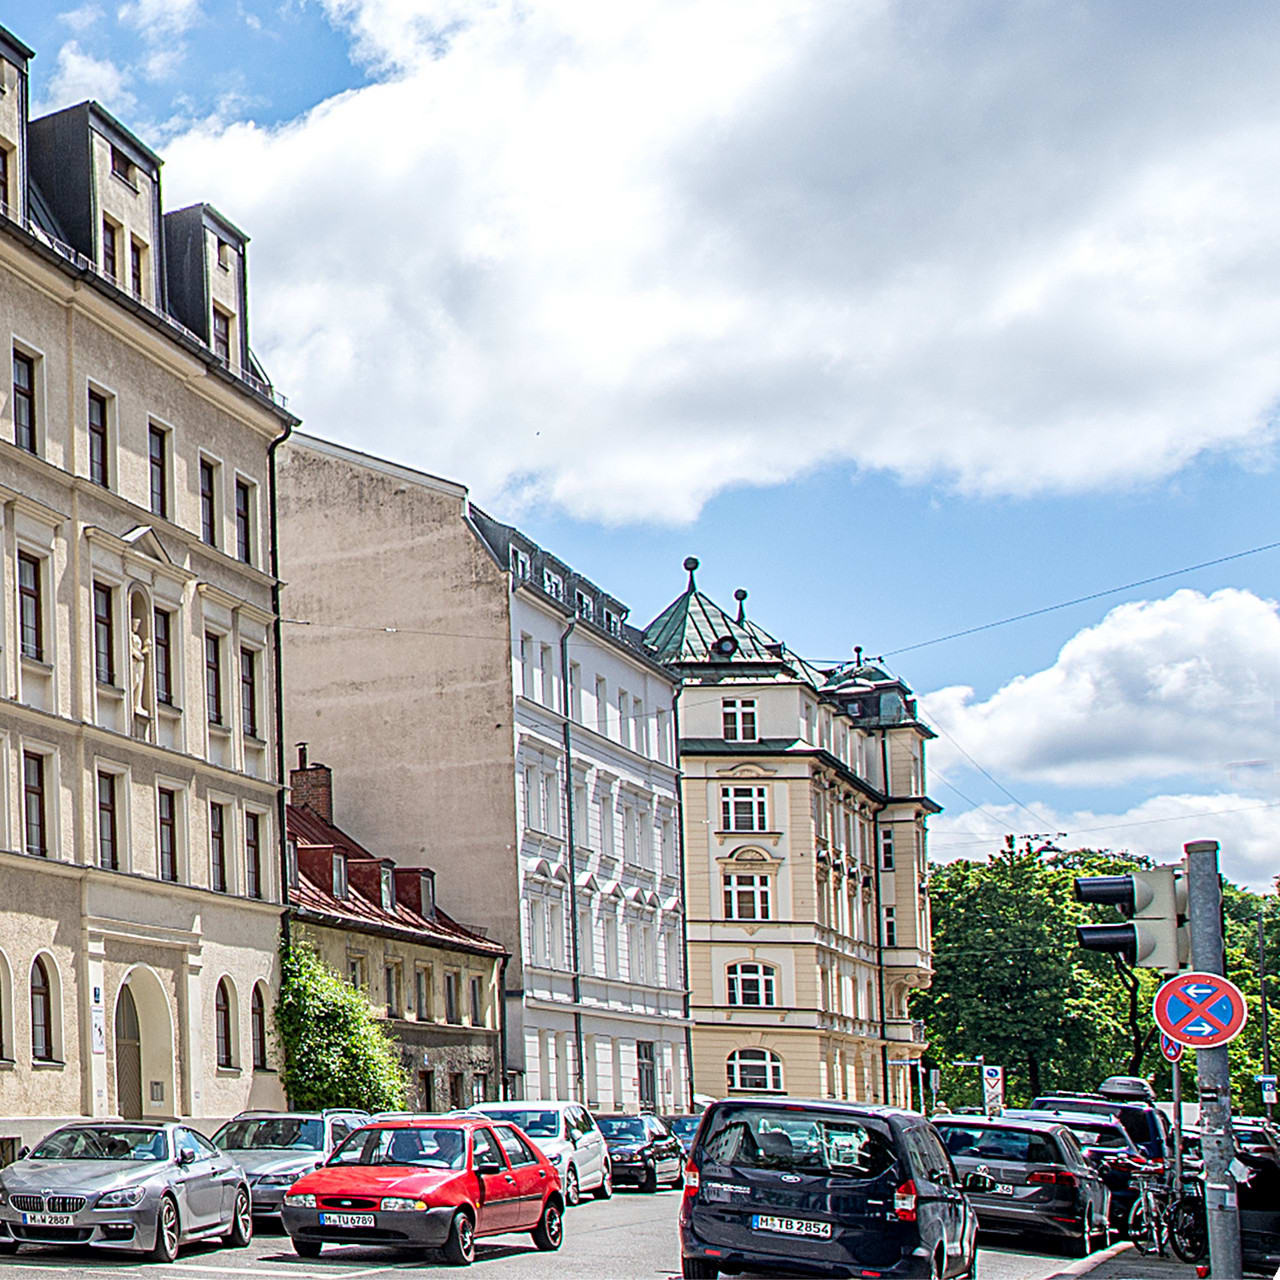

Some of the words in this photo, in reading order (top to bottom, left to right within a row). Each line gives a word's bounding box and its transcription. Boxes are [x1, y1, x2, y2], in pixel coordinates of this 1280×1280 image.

[29, 1214, 36, 1224] M
[48, 1215, 70, 1225] 2887
[325, 1214, 332, 1224] M
[337, 1215, 349, 1225] TU
[350, 1215, 373, 1225] 6789
[759, 1216, 769, 1227] M
[777, 1218, 793, 1230] TB
[796, 1220, 830, 1234] 2854
